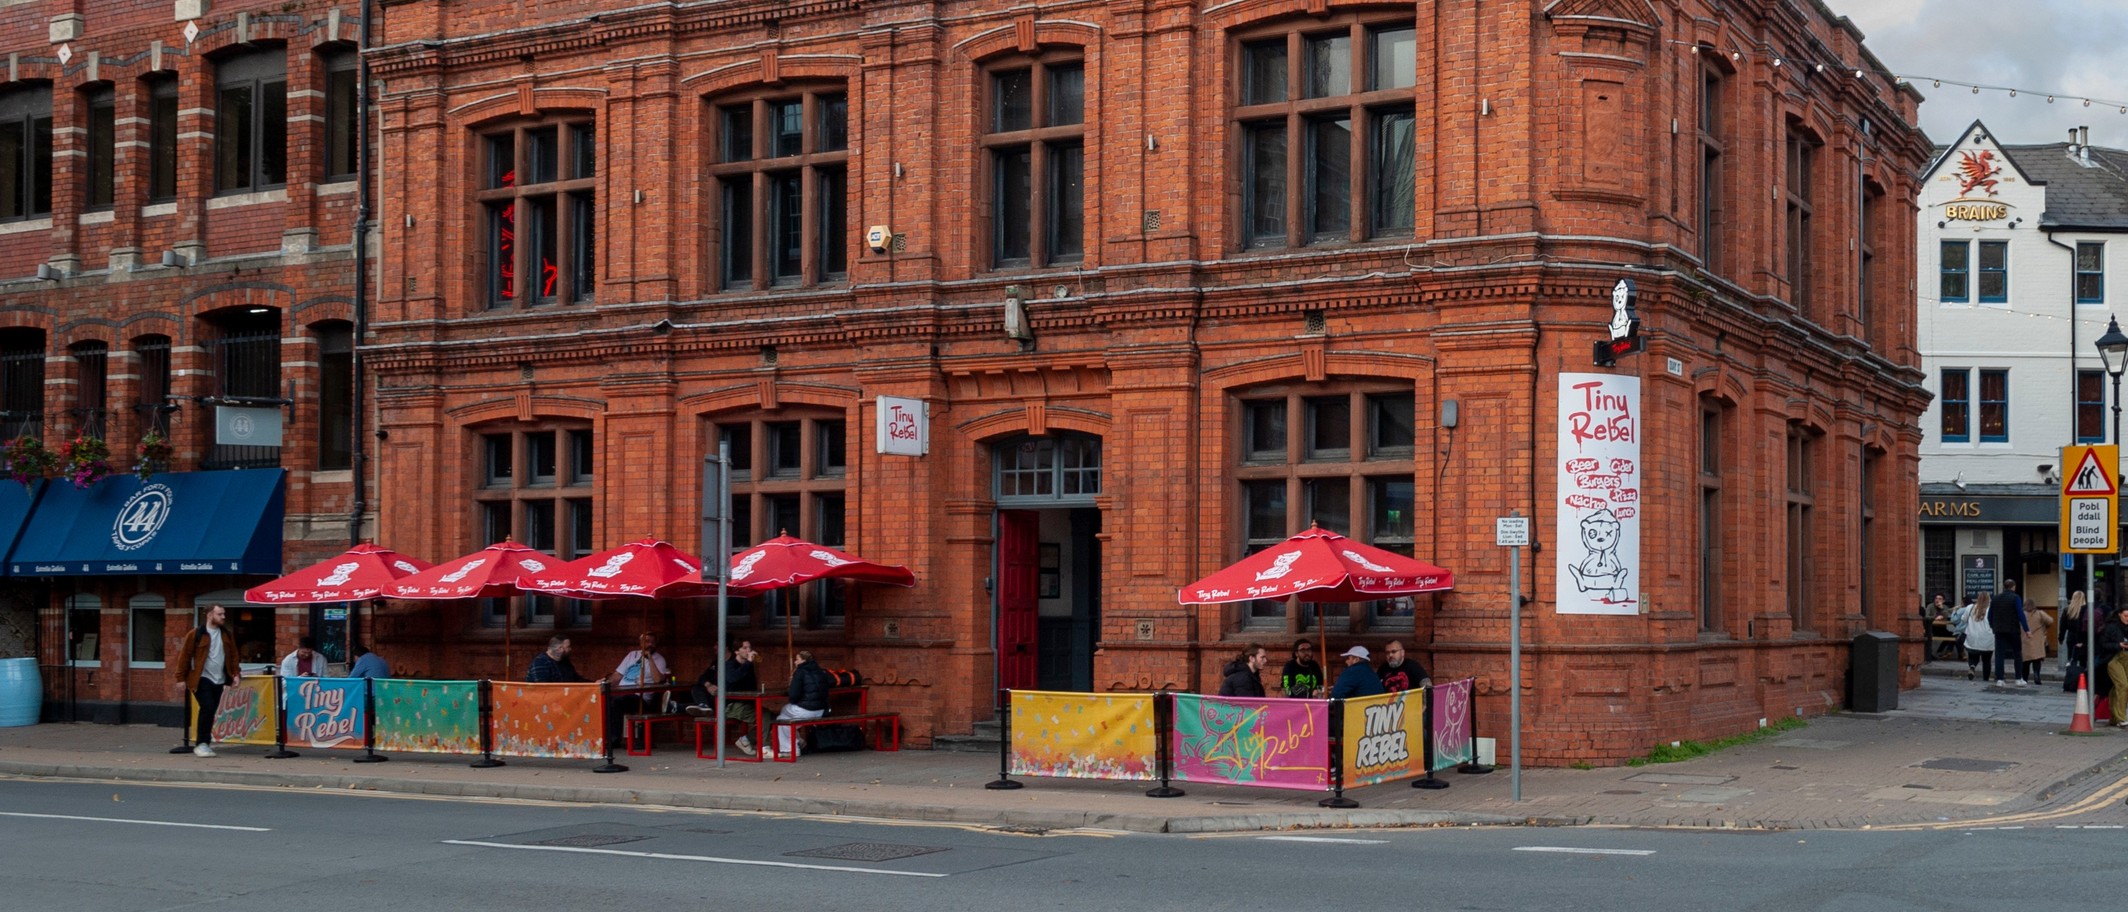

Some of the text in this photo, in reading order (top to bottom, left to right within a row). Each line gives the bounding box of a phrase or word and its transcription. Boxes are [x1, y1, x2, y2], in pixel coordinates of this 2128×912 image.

[1946, 205, 2008, 220] BRAINS
[1572, 382, 1630, 423] Tiny
[890, 406, 914, 428] Tiny
[889, 422, 917, 441] Rebel
[1568, 412, 1634, 444] Rebel
[1568, 460, 1632, 473] Beer Cider
[1579, 475, 1620, 488] Burgers
[124, 491, 142, 507] BAR
[143, 484, 166, 492] FORTY
[1570, 496, 1606, 509] Nachos
[1918, 502, 1980, 516] ARMS
[2078, 512, 2100, 520] ddall
[2080, 502, 2100, 510] Pobl
[123, 502, 162, 532] 44
[2074, 536, 2104, 545] people
[1197, 585, 1278, 601] Tiny Rebel Tiny Rebel
[300, 680, 344, 717] Tiny
[295, 708, 357, 748] Rebel
[1365, 701, 1404, 736] TINY
[1204, 703, 1320, 779] Tiny Rebel
[1356, 730, 1409, 769] REBEL
